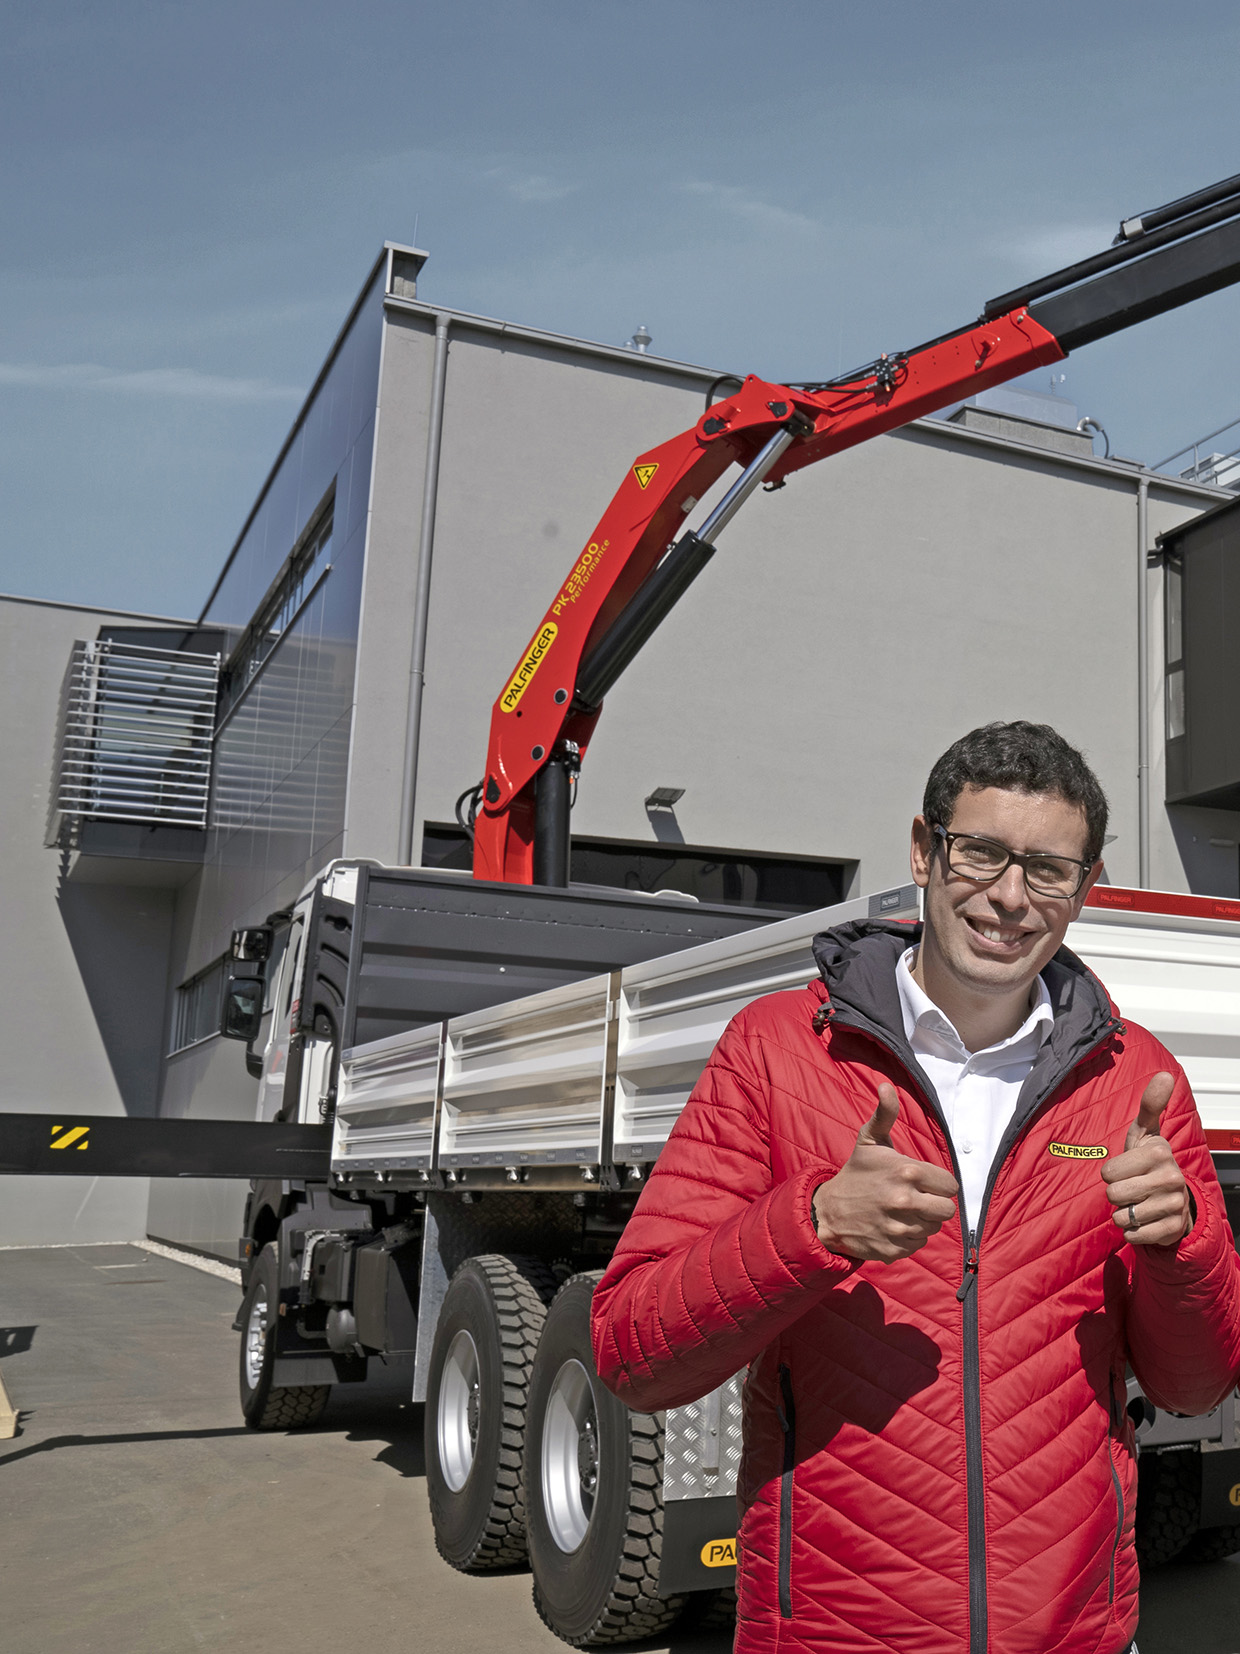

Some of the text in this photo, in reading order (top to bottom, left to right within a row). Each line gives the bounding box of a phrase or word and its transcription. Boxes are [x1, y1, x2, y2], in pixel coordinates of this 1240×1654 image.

[552, 542, 599, 617] PK 23500
[570, 539, 611, 604] Performance
[503, 627, 555, 708] PALFINGER
[1052, 1144, 1104, 1157] PALFINGER
[709, 1544, 737, 1562] PA
